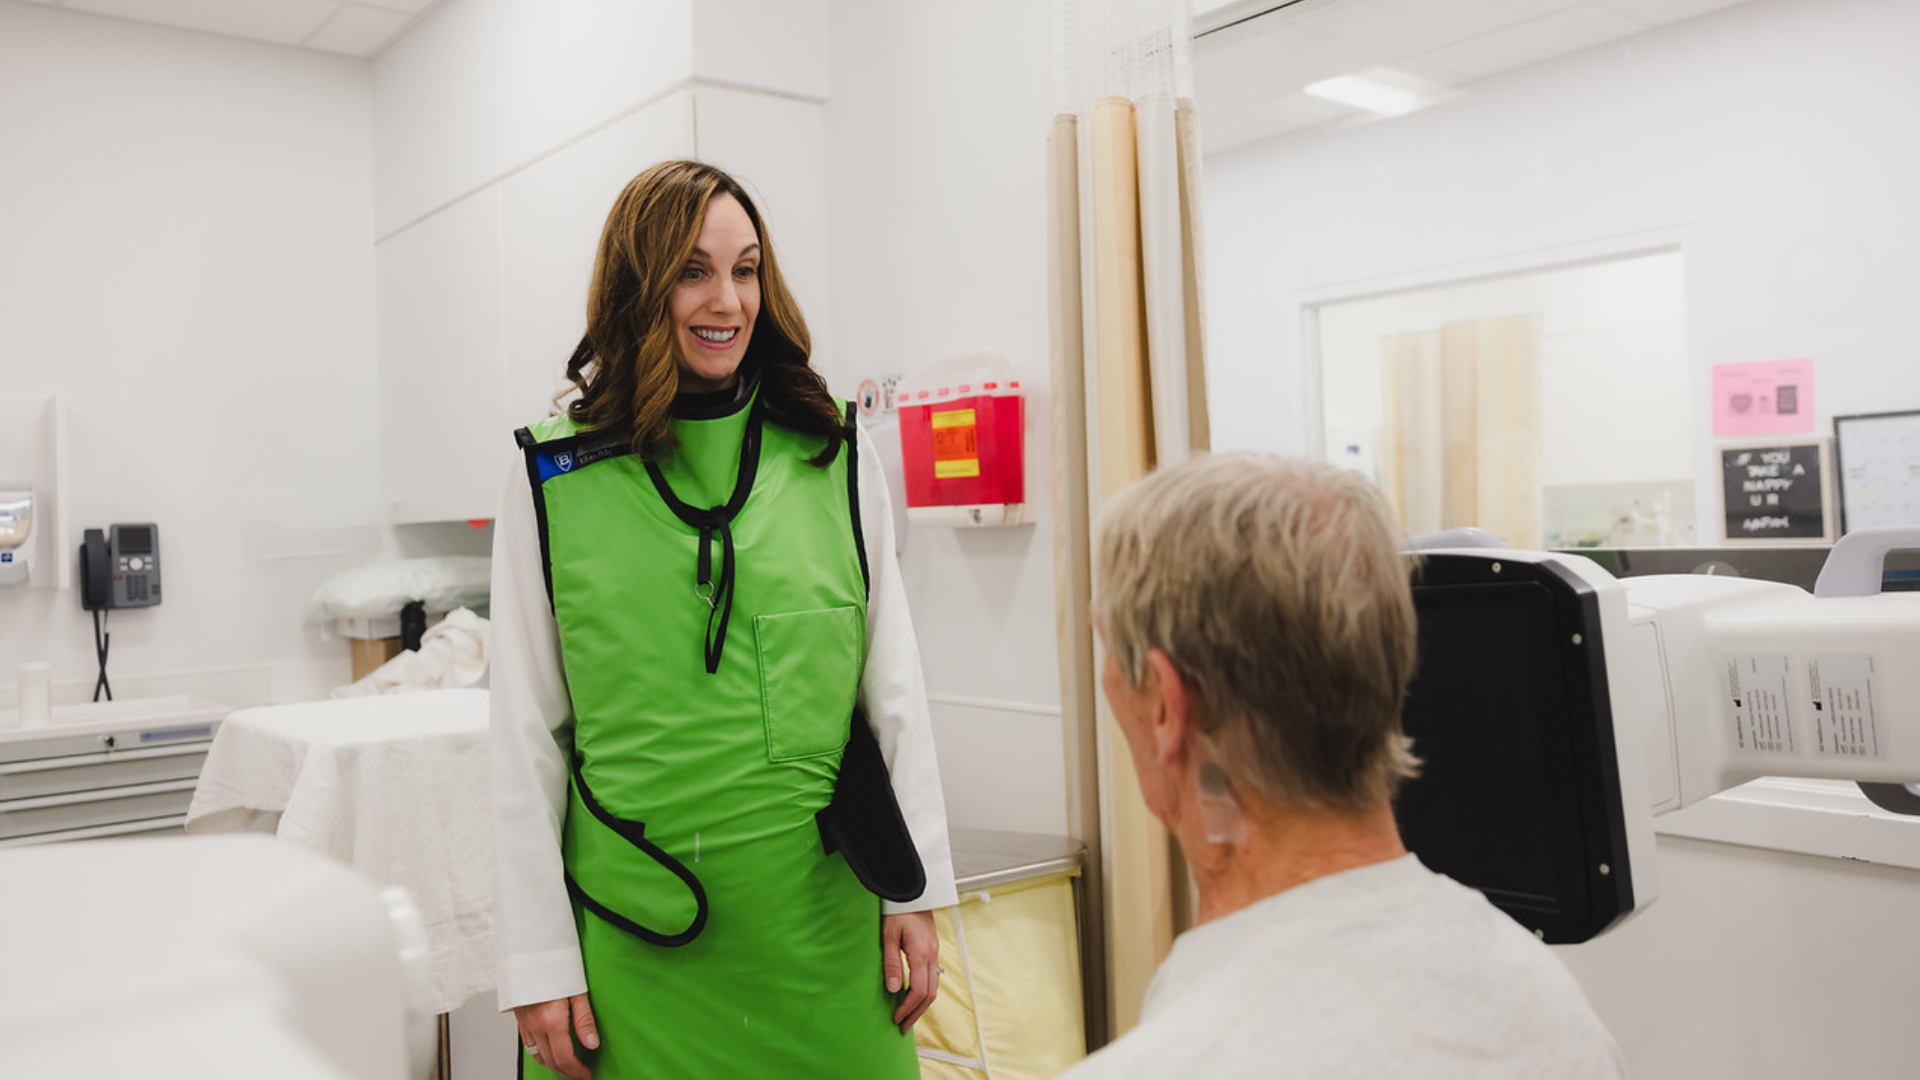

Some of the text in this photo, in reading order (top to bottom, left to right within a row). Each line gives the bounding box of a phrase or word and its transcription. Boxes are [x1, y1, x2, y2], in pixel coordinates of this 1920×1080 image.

[1761, 451, 1790, 464] YOU
[1792, 463, 1806, 476] A
[1749, 494, 1762, 507] U
